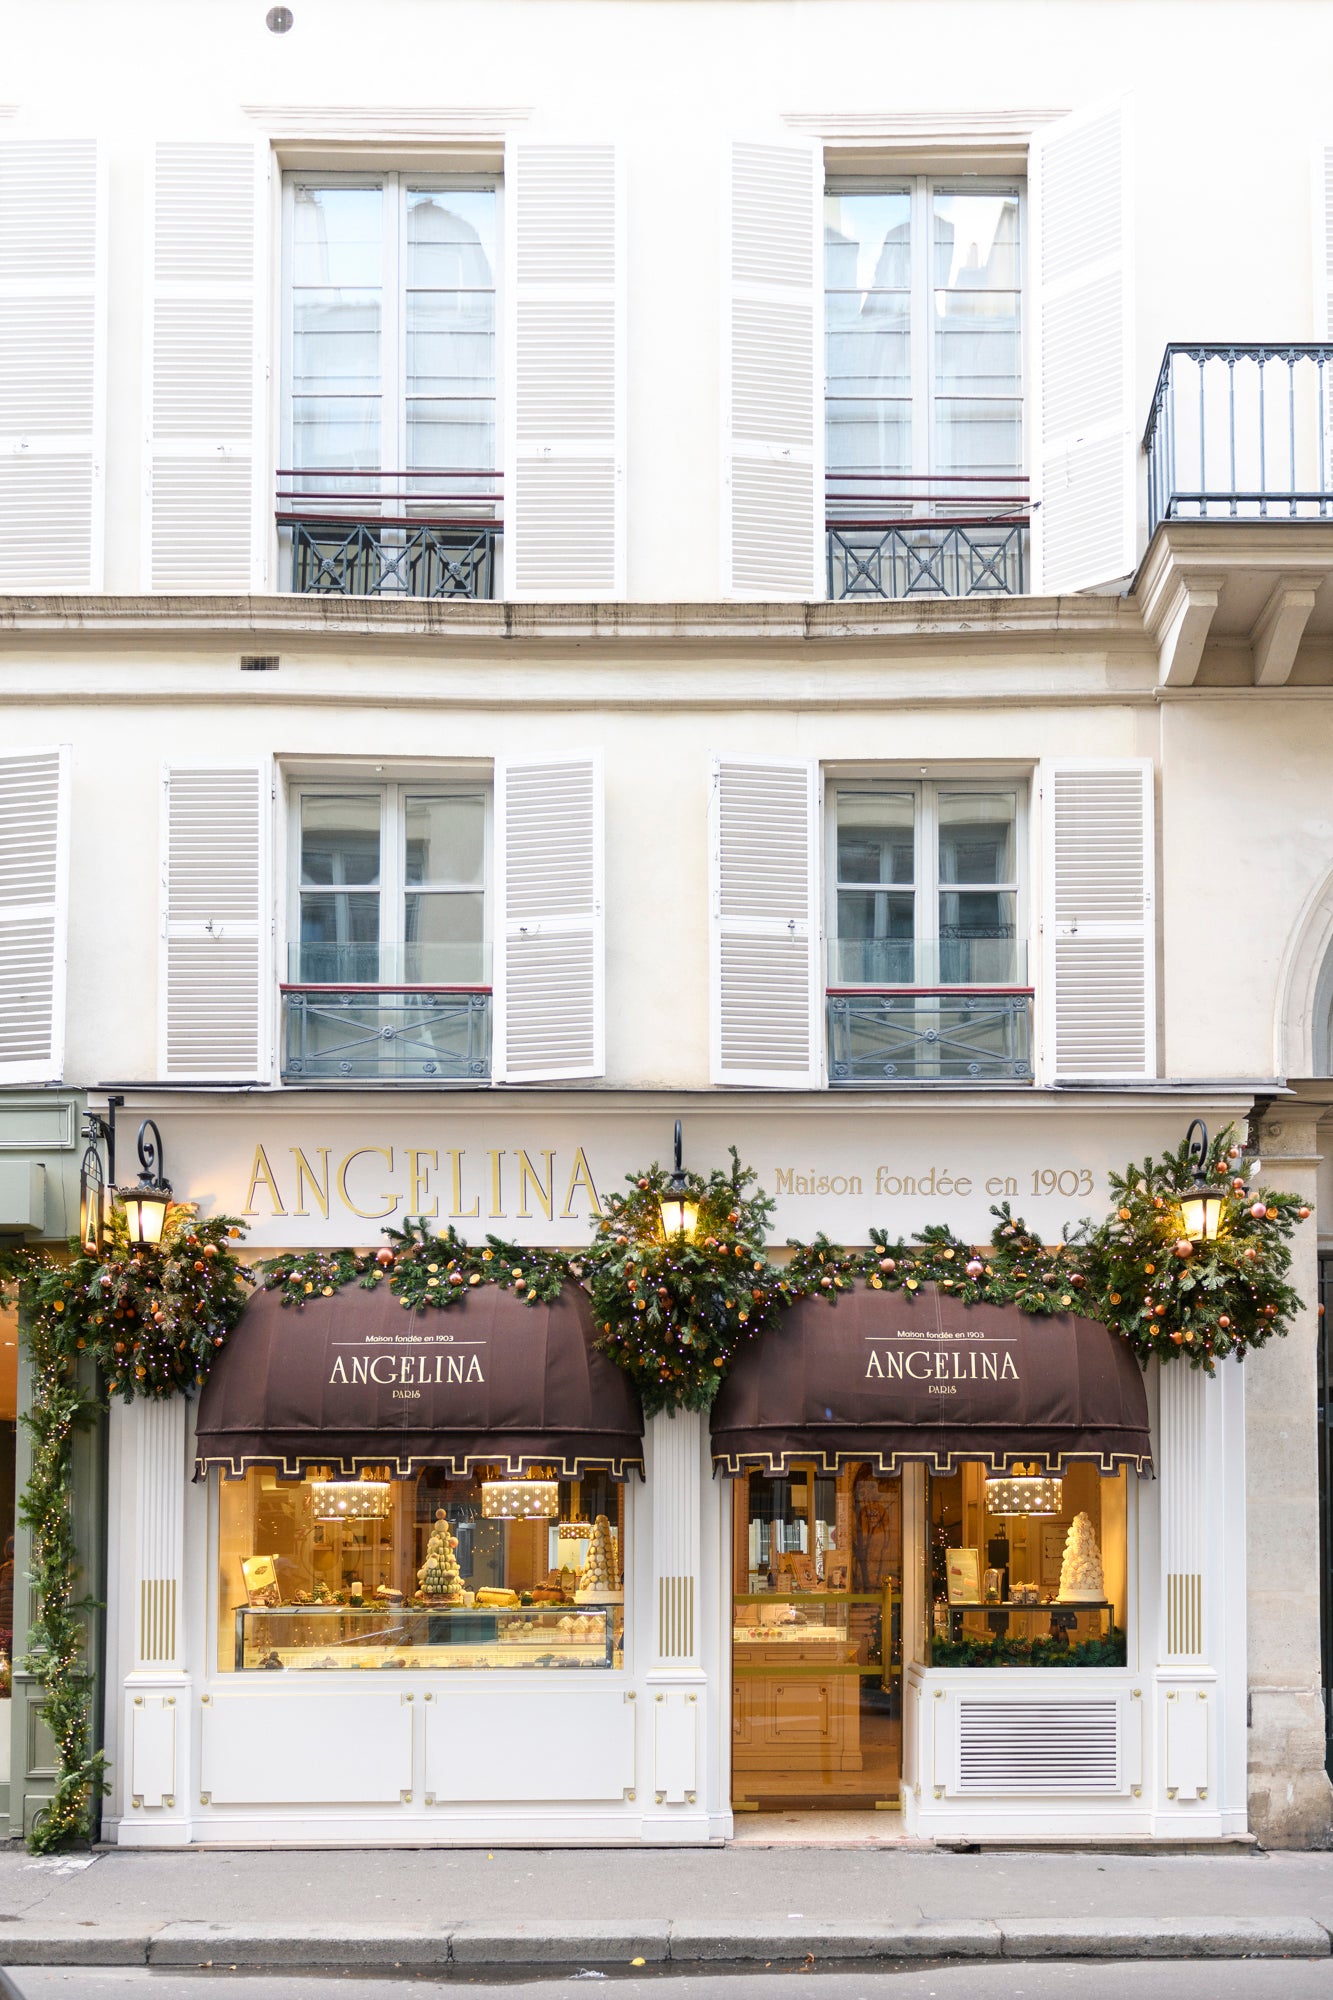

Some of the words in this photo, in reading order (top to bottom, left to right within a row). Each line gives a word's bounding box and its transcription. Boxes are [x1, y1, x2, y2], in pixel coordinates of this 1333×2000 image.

[241, 1144, 602, 1221] ANGELINA
[775, 1167, 863, 1196] Maison
[875, 1166, 972, 1196] fondée
[985, 1176, 1019, 1196] en
[1031, 1168, 1094, 1197] 1903
[365, 1335, 393, 1343] Maison
[395, 1334, 423, 1342] fondée
[897, 1330, 925, 1338] Maison
[926, 1331, 954, 1339] fondée
[967, 1331, 985, 1339] 1903
[329, 1354, 485, 1385] ANGELINA
[865, 1350, 1020, 1381] ANGELINA
[392, 1389, 421, 1399] PARIS
[928, 1385, 957, 1395] PARIS
